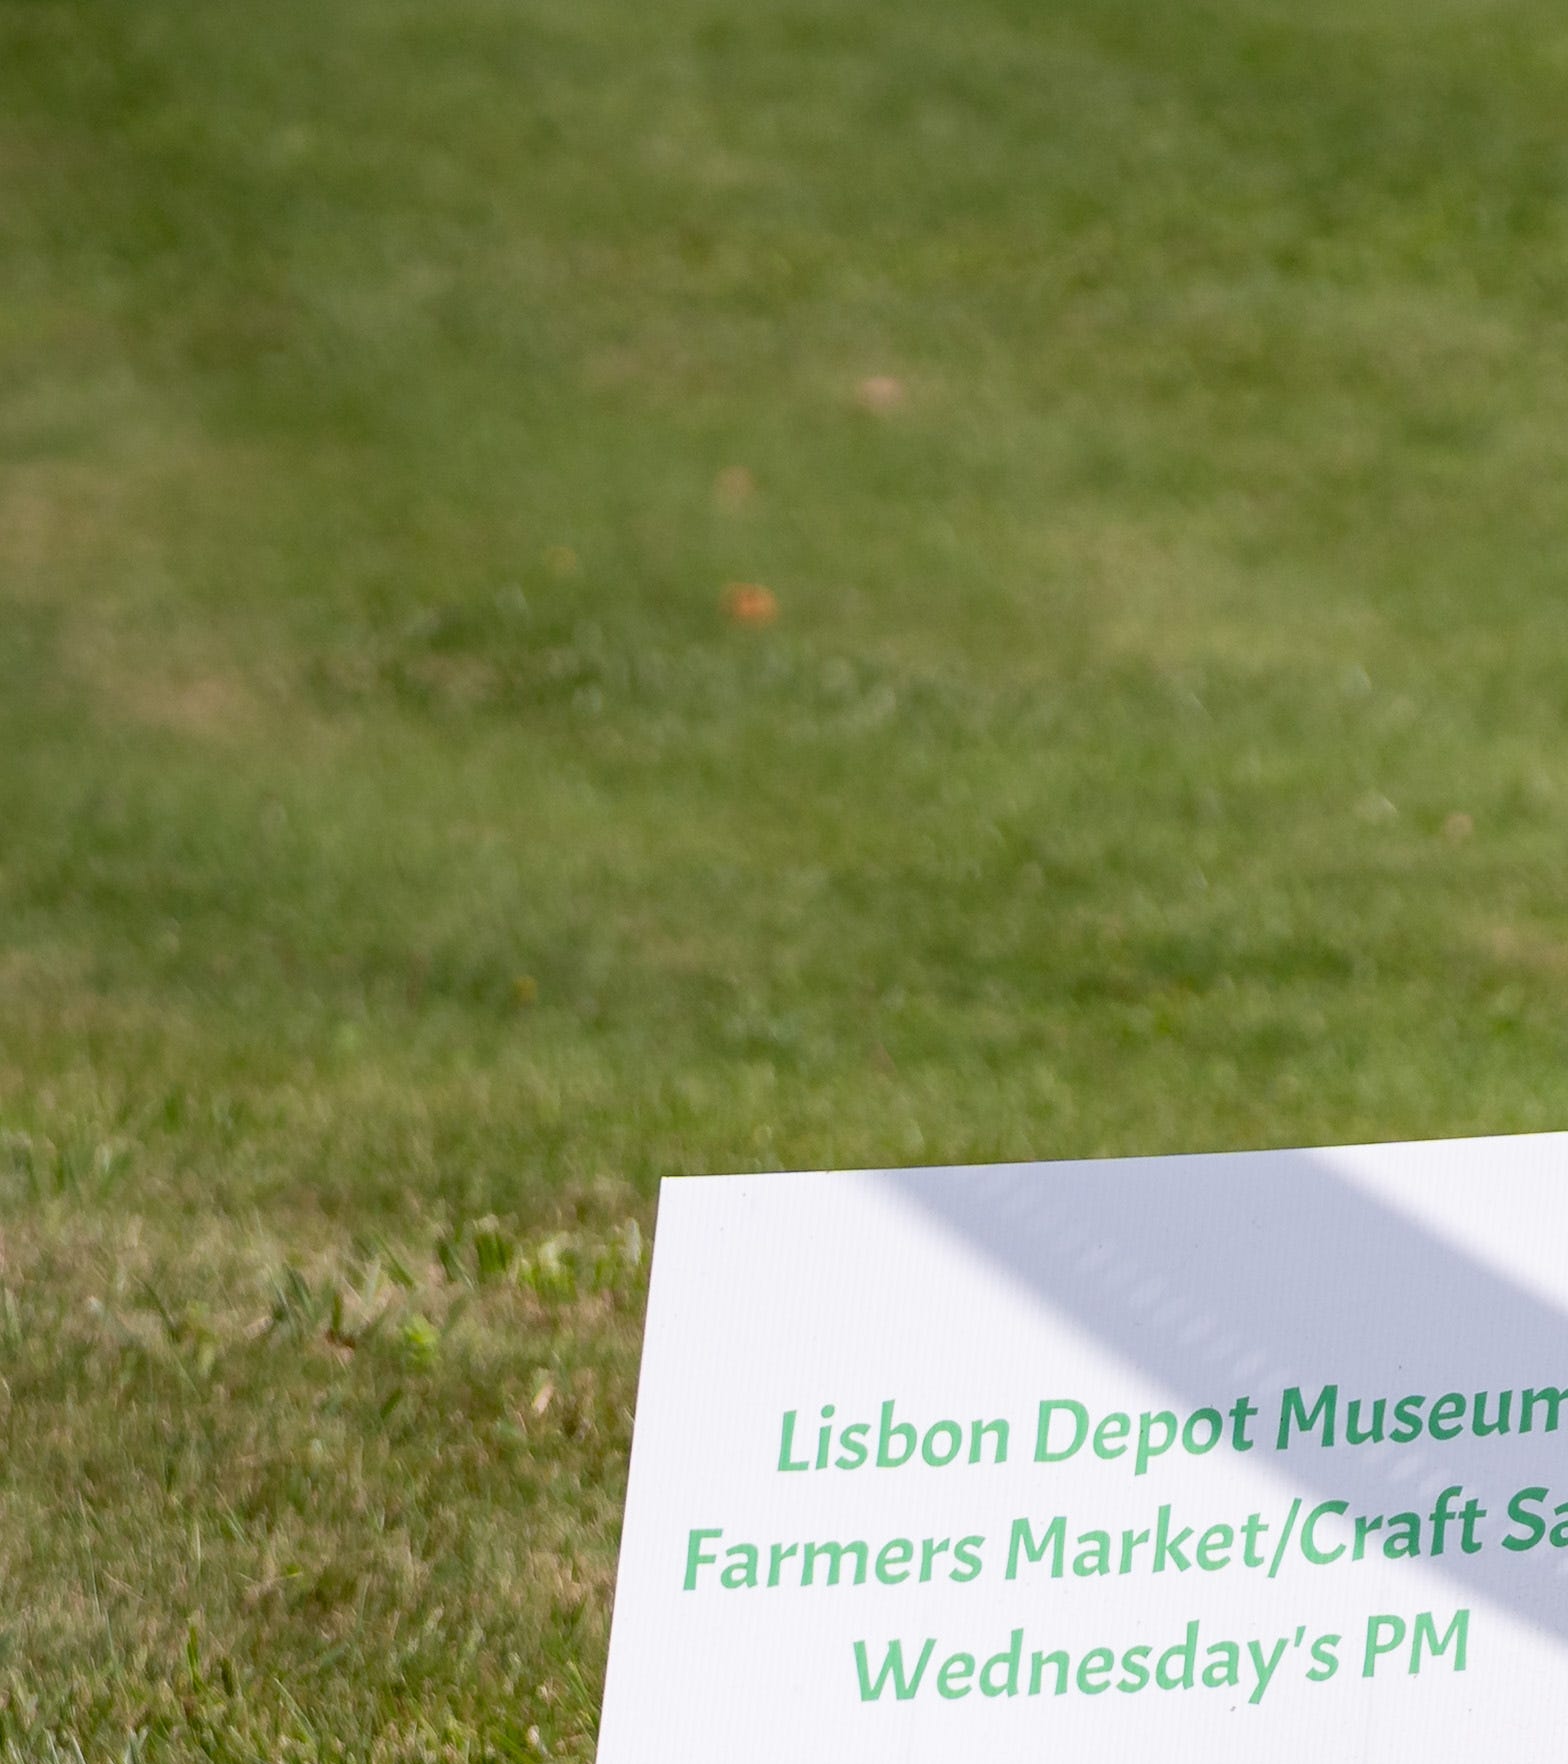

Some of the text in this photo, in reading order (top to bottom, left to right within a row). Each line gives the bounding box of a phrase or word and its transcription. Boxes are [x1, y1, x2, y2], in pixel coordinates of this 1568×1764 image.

[777, 1401, 1009, 1473] Lisbon
[1034, 1396, 1257, 1476] Depot
[683, 1528, 984, 1591] Farmers
[1005, 1486, 1486, 1580] Market/Craft
[853, 1608, 1471, 1705] Wednesday's PM
